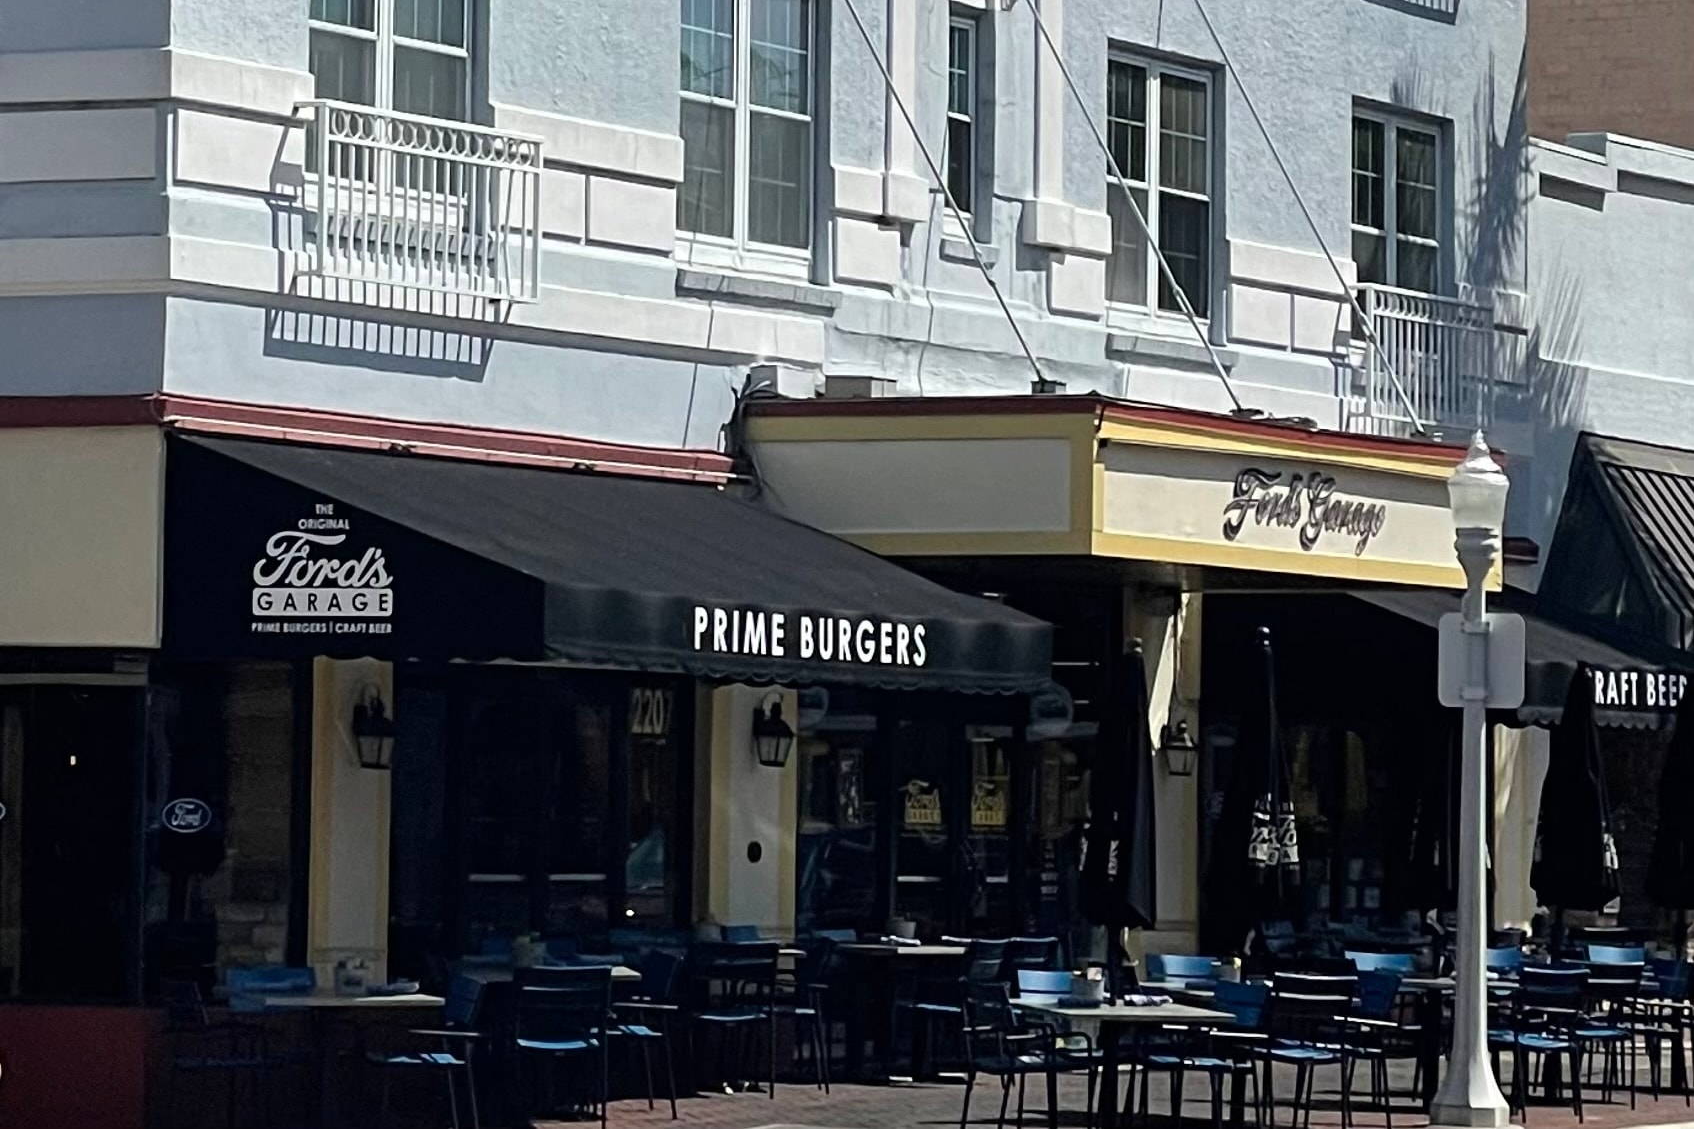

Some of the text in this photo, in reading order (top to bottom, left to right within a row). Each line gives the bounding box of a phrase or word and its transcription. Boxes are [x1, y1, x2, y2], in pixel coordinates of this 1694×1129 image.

[315, 503, 334, 515] THE
[298, 518, 350, 530] ORIGINAL
[253, 530, 394, 588] Ford's
[257, 592, 389, 612] GARAGE
[251, 622, 392, 634] PRIME BURGERS CRAFT BEER
[693, 605, 928, 668] PRIME BURGERS
[1586, 668, 1639, 706] RAFT
[171, 802, 203, 826] Ford
